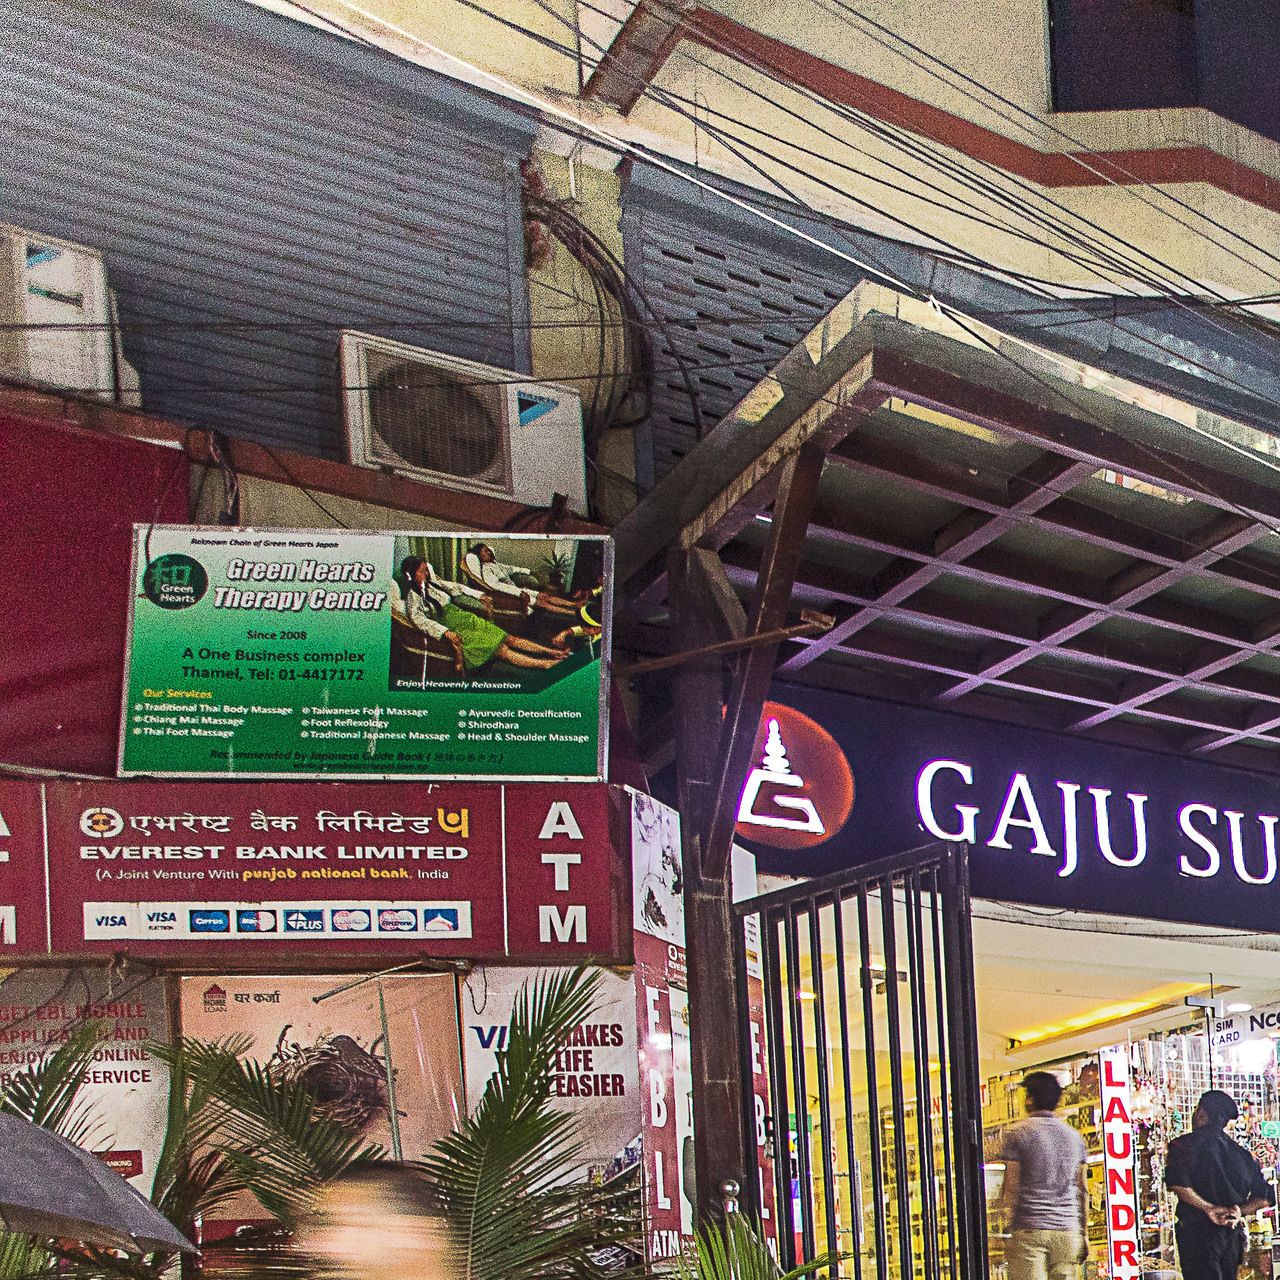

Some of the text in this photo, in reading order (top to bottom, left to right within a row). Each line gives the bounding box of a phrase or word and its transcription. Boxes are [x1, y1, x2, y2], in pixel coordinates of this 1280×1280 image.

[226, 558, 376, 583] Green Hearts
[160, 583, 194, 594] Green
[160, 592, 195, 603] Hearts
[214, 585, 387, 612] Therapy Center
[247, 630, 307, 641] Since 2008
[199, 648, 365, 665] One Business complex
[182, 666, 365, 681] Thamel, Tel: 01-4417172
[396, 680, 522, 690] Enjoy Heavenly Relaxation
[144, 702, 293, 716] Traditional Thai Body Massage
[310, 706, 428, 718] Taiwanese Massage
[468, 709, 582, 719] Ayurvedic Detoxification
[143, 715, 245, 727] Chiang Massage
[310, 718, 389, 729] Foot Reflexology
[468, 721, 520, 730] Shirodhara
[143, 727, 235, 738] Thai Foot Massage
[310, 730, 450, 742] Traditional Japanese Massage
[468, 733, 589, 744] Head Shoulder Massage
[315, 810, 433, 835] लिमिटेड
[913, 757, 1149, 878] GAJU
[80, 846, 469, 860] EVEREST BANK LIMITED
[117, 867, 449, 882] Joint Venture With punjab national India
[538, 801, 588, 943] ATM
[96, 915, 128, 927] VISA
[146, 911, 177, 923] VISA
[194, 917, 223, 926] Cirrus
[296, 919, 323, 930] PLUS
[36, 1002, 146, 1020] EBL MOBILE
[1215, 1018, 1234, 1034] SIM
[114, 1027, 150, 1042] AND
[0, 1049, 151, 1065] ENJOY ONLINE
[556, 1050, 594, 1073] LIFE
[82, 1069, 152, 1085] SERVICE
[555, 1074, 626, 1098] EASIER
[652, 1229, 681, 1258] ATM
